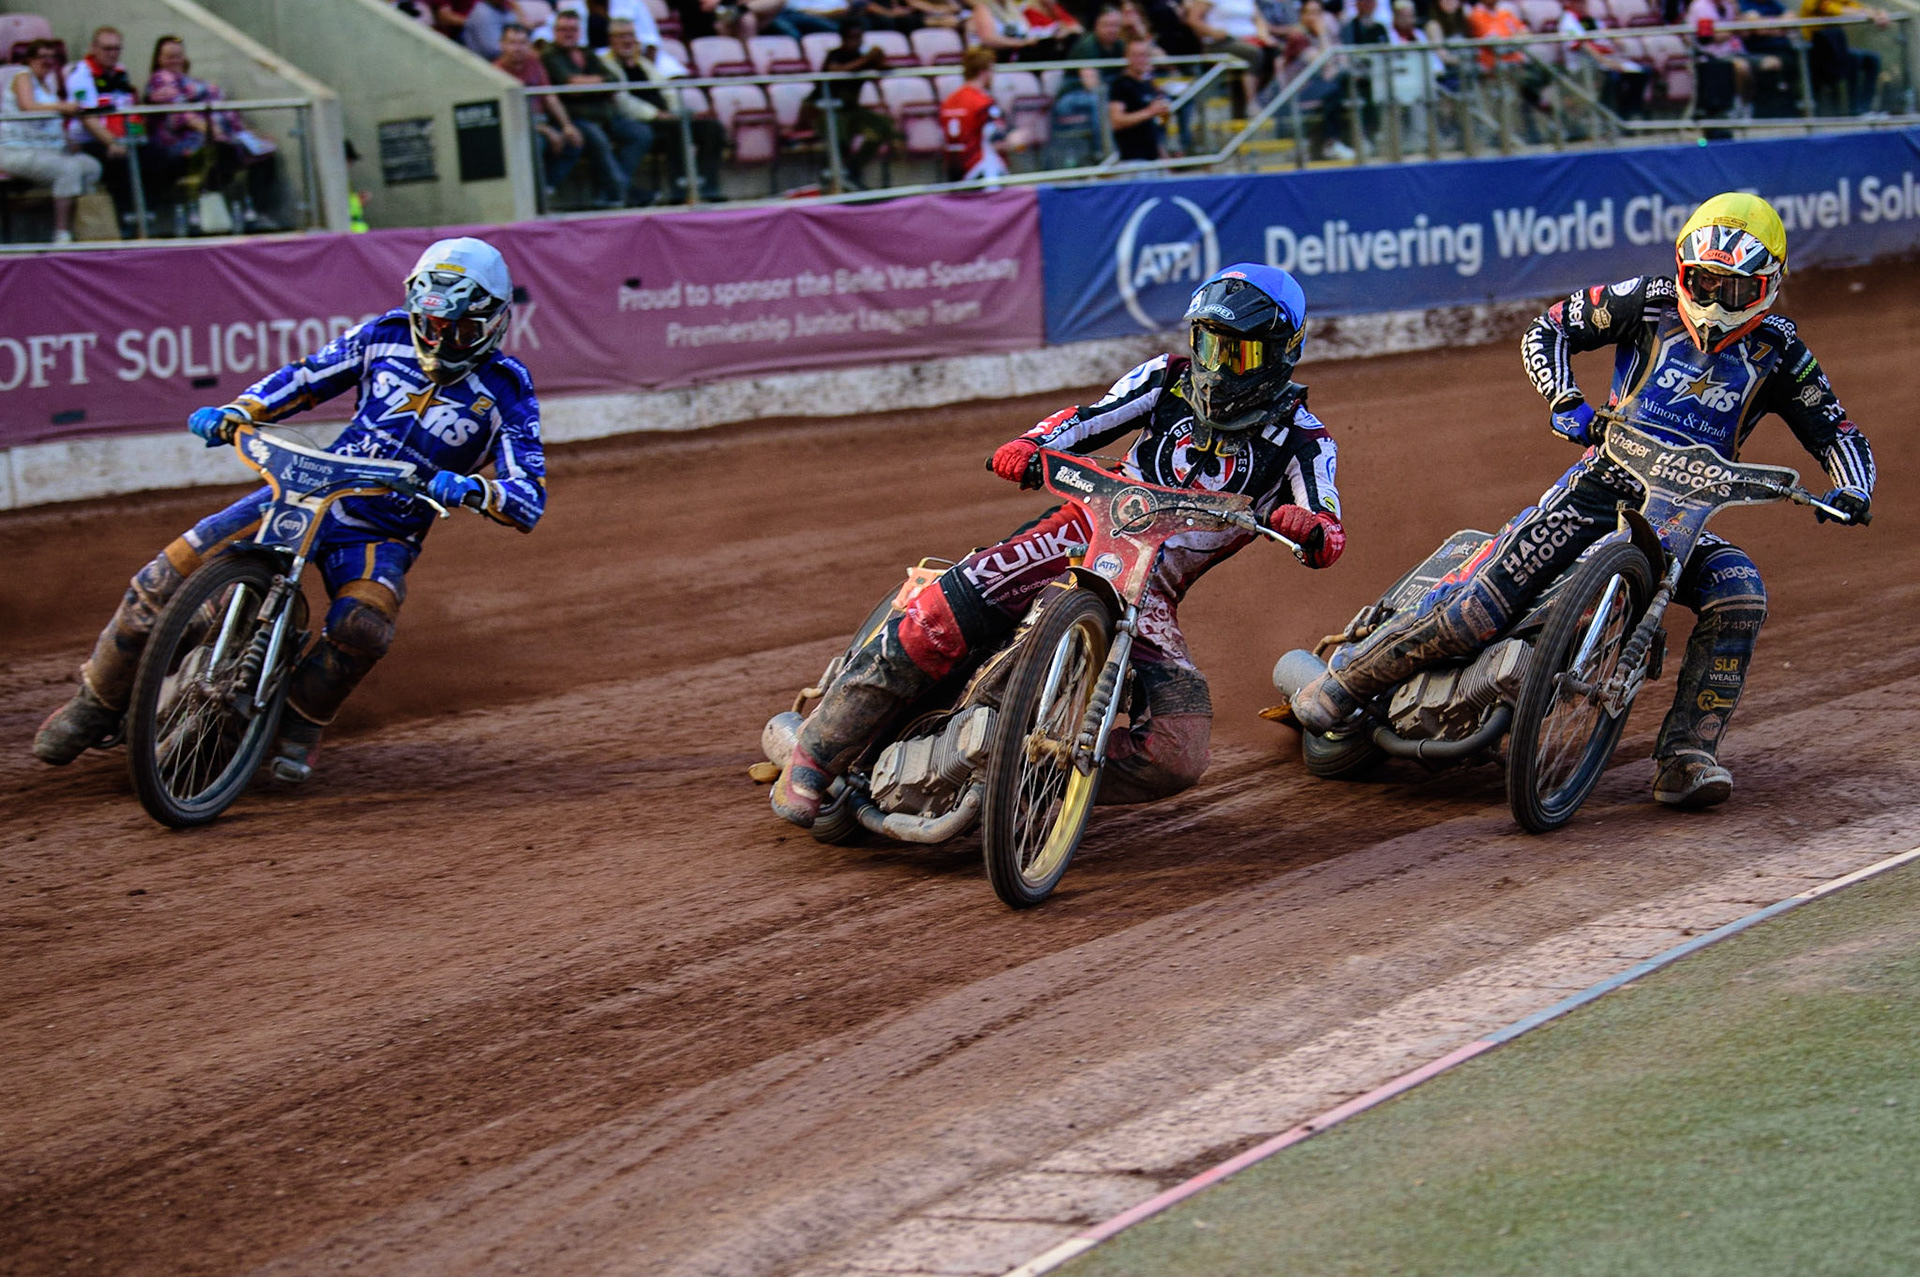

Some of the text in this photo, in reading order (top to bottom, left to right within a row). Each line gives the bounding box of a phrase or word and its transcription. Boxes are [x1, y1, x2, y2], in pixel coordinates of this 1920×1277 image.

[1264, 171, 1920, 277] Delivering World Cla avel Sol
[618, 281, 681, 312] Proud
[685, 283, 711, 307] to
[713, 278, 792, 309] sponsor
[796, 271, 831, 297] the
[1645, 287, 1678, 299] SHOC
[1646, 278, 1677, 292] HAG
[666, 313, 791, 348] Premiership
[116, 312, 382, 382] SOLICITO
[469, 396, 493, 417] 2
[1641, 396, 1682, 423] Minors
[1682, 411, 1698, 429] &
[1699, 420, 1730, 441] Brady
[280, 464, 297, 481] &
[292, 454, 334, 475] Minors
[1237, 447, 1248, 473] CES
[1656, 452, 1741, 483] HAGON
[1649, 464, 1733, 498] SHOCKS
[1502, 503, 1581, 575] HAGON
[1512, 513, 1595, 587] SHOCKS
[1709, 673, 1742, 683] WEALTH
[1714, 658, 1740, 672] SLR
